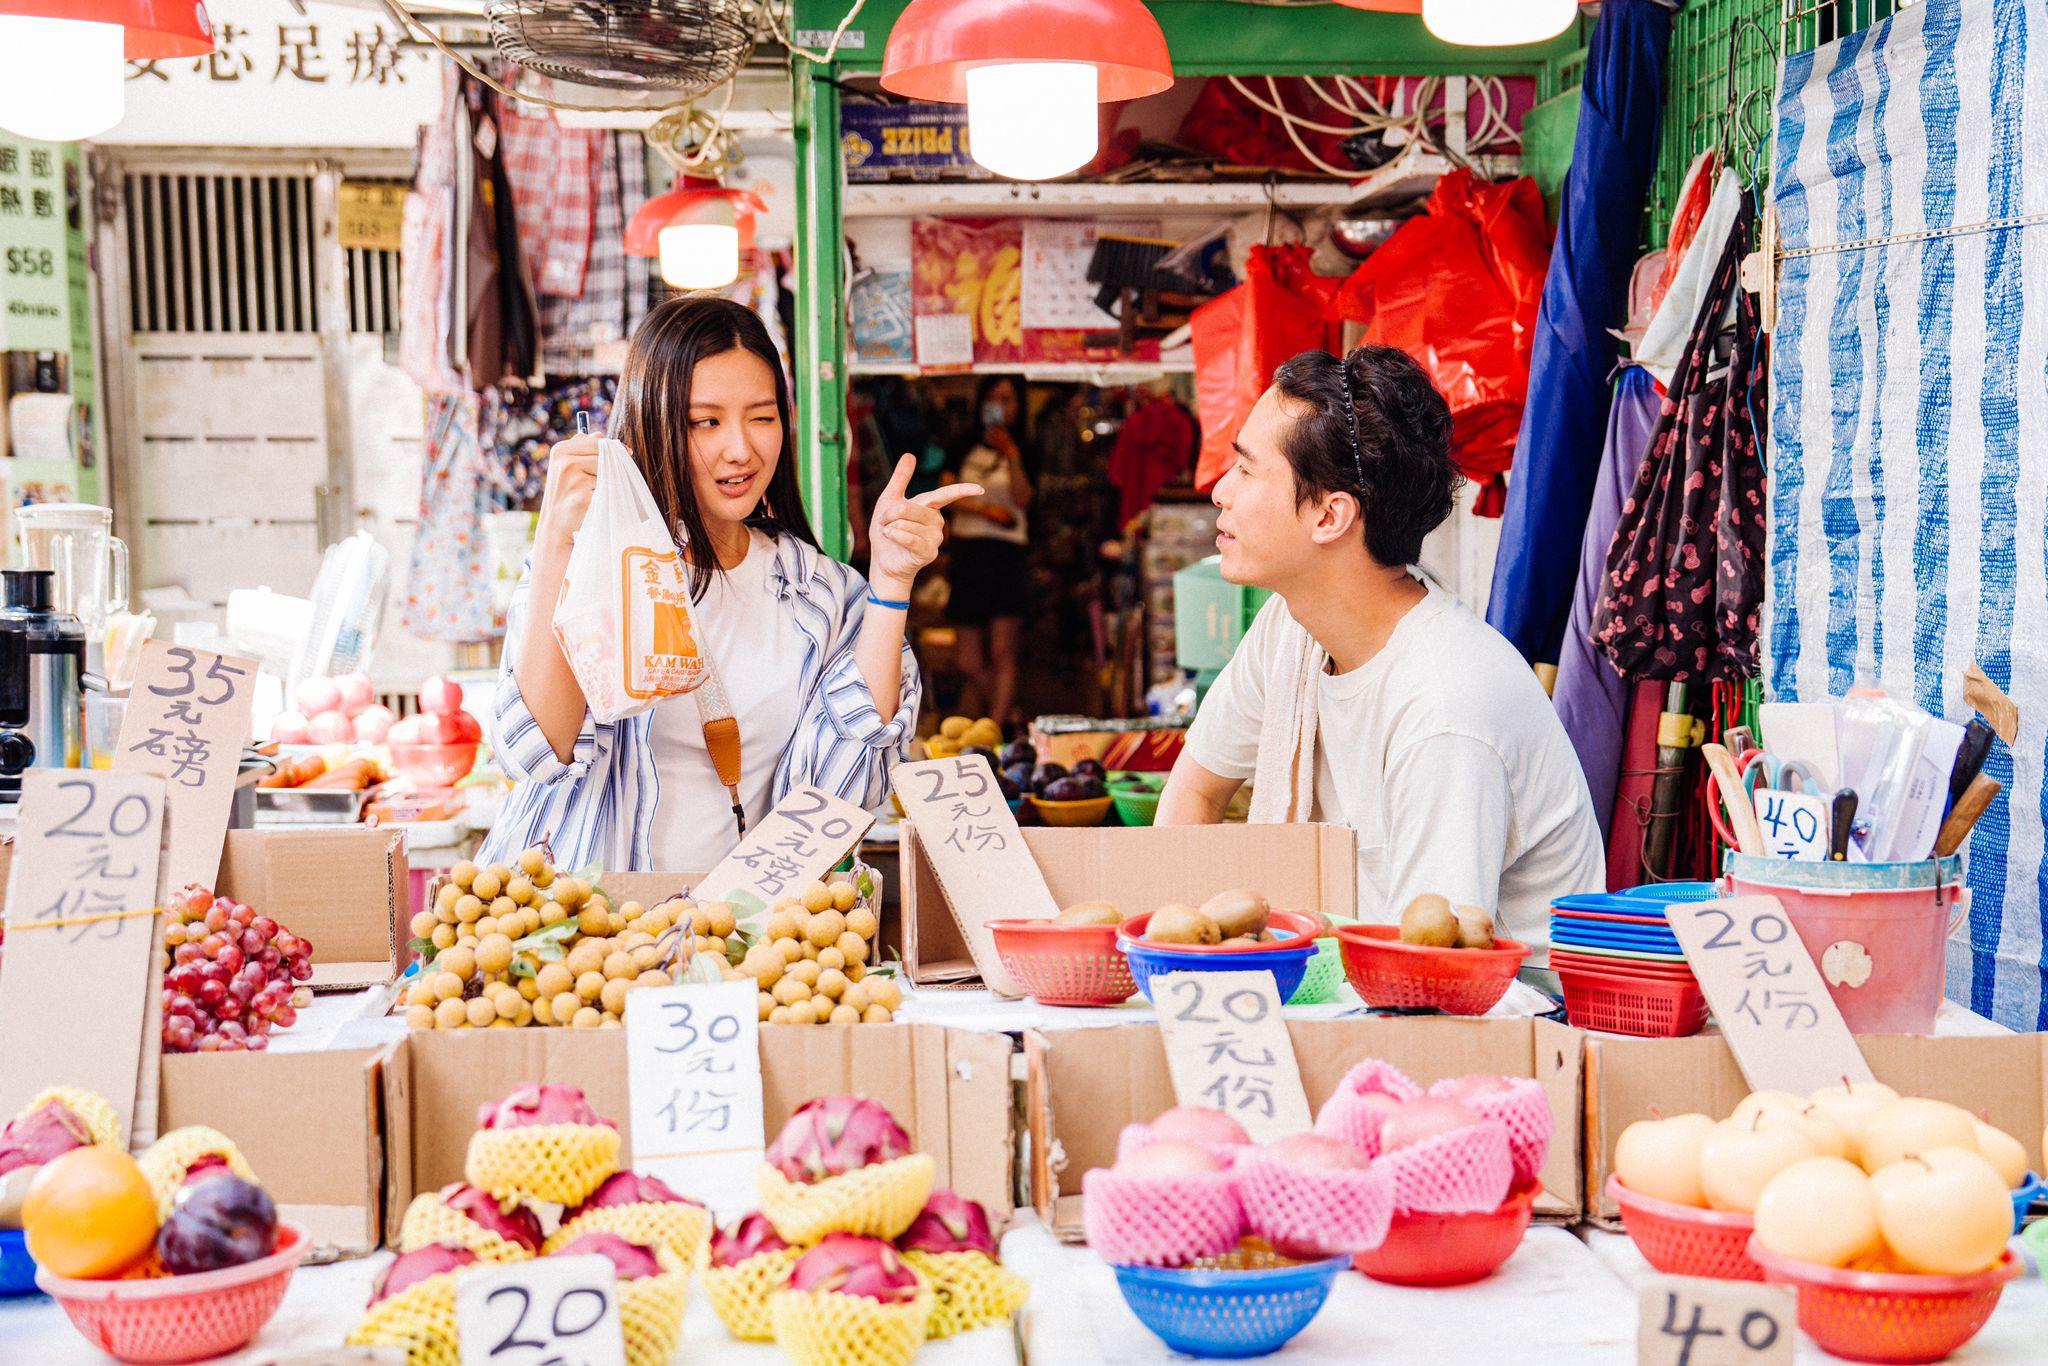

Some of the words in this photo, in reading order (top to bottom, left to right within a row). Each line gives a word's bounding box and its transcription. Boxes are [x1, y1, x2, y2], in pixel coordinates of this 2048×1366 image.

[881, 127, 953, 155] PRIZE
[7, 247, 54, 276] $58
[148, 648, 246, 706] 35
[642, 655, 676, 668] KAM
[163, 700, 203, 725] 元
[914, 760, 988, 803] 25
[44, 779, 152, 838] 20
[776, 790, 853, 839] 20
[950, 803, 992, 822] 元
[1763, 796, 1817, 844] 40
[776, 831, 819, 858] 元
[944, 824, 1007, 853] 份
[74, 843, 139, 881] 元
[34, 887, 127, 944] 份
[1694, 908, 1789, 950] 20
[1742, 950, 1793, 980] 元
[1170, 980, 1269, 1025] 20
[1733, 988, 1820, 1030] 份
[654, 1002, 740, 1054] 30
[1202, 1031, 1277, 1067] 元
[685, 1048, 736, 1074] 元
[655, 1087, 738, 1133] 份
[1202, 1074, 1275, 1118] 份
[486, 1285, 608, 1357] 20
[1660, 1291, 1779, 1366] 40
